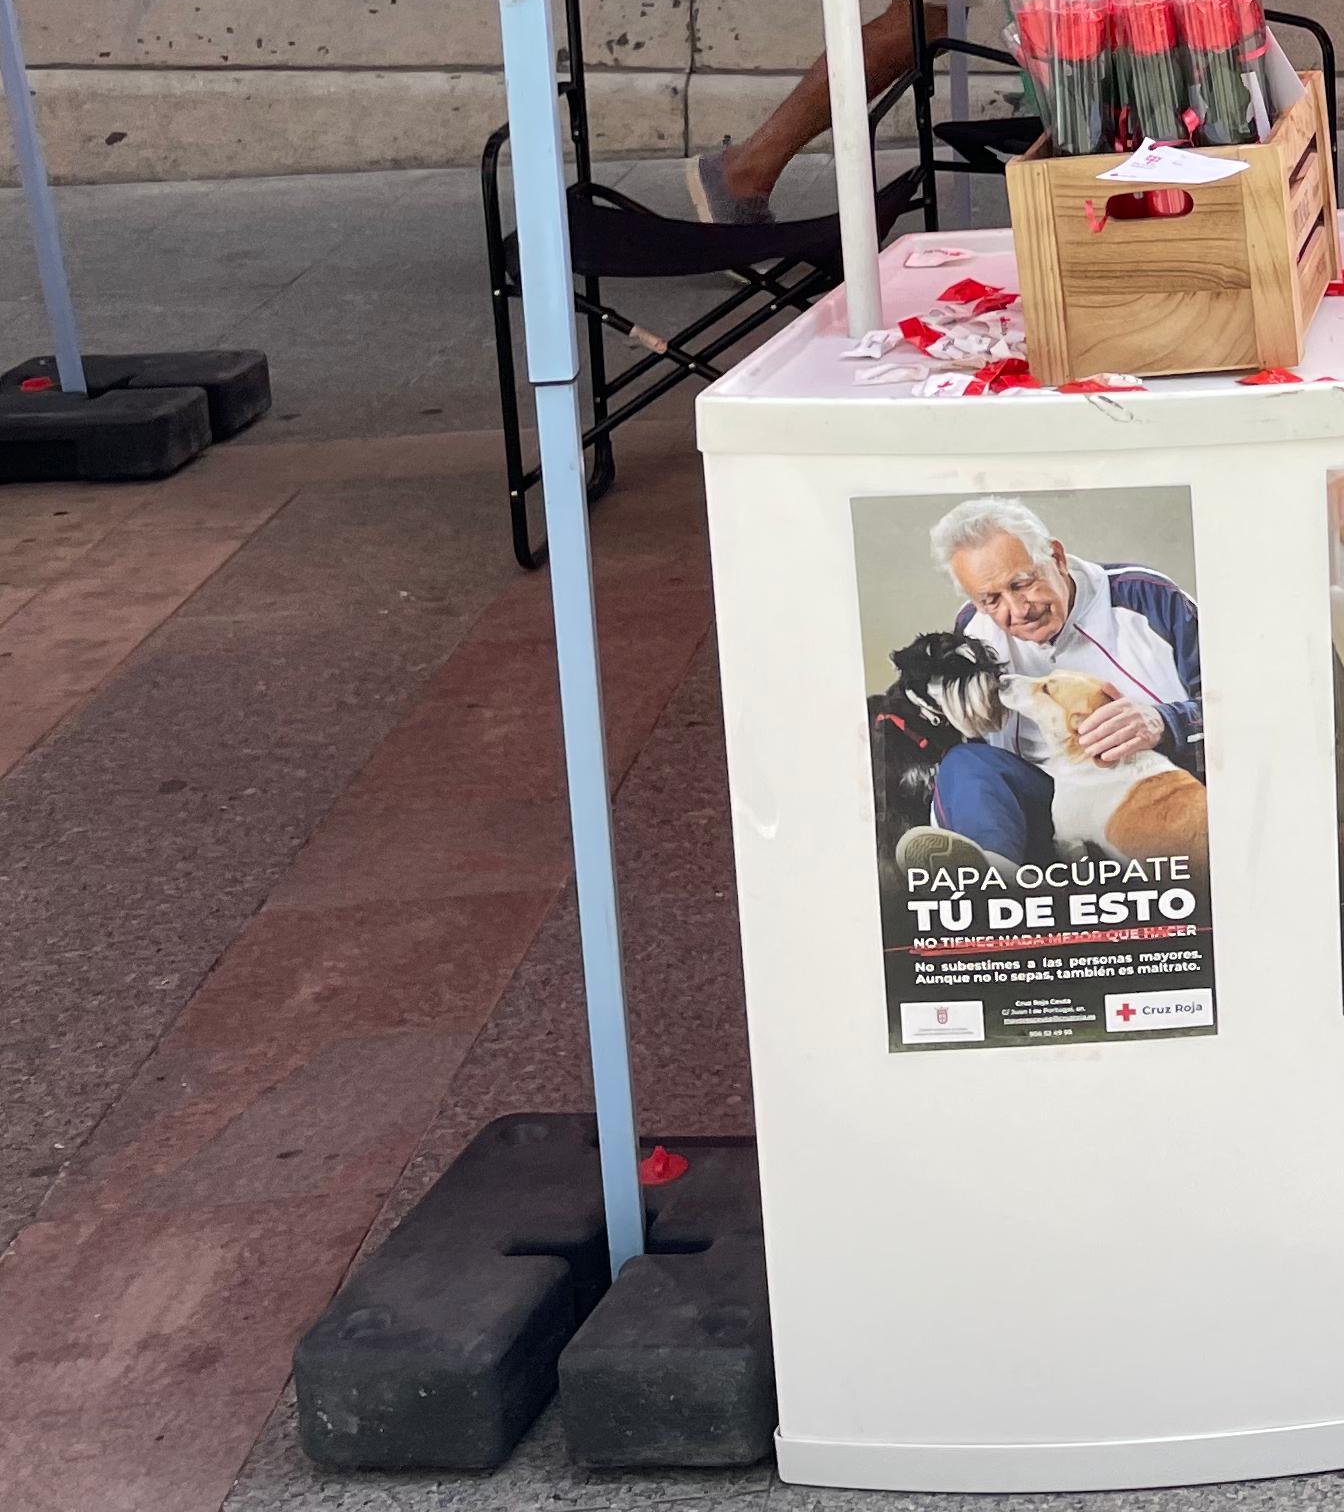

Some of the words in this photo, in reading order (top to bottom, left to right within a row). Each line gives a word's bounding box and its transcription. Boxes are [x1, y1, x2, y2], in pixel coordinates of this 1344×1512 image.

[907, 866, 1007, 892] PAPA
[1016, 855, 1191, 889] OCÚPATE
[907, 891, 973, 931] TÚ
[988, 896, 1055, 929] DE
[1069, 888, 1196, 925] ESTO
[913, 937, 938, 949] NO
[915, 962, 935, 972] No
[941, 959, 1020, 971] subestimes
[1027, 960, 1036, 969] a
[1043, 957, 1062, 968] las
[1069, 953, 1133, 968] personas
[1139, 950, 1202, 963] mayores.
[915, 973, 970, 985] Aunque
[973, 973, 992, 982] no
[994, 971, 1007, 982] lo
[1011, 970, 1054, 983] sepas,
[1056, 966, 1115, 979] también
[1118, 965, 1134, 975] es
[1137, 962, 1201, 974] maltrato.
[1142, 1004, 1172, 1016] Cruz
[1174, 1002, 1203, 1015] Roja
